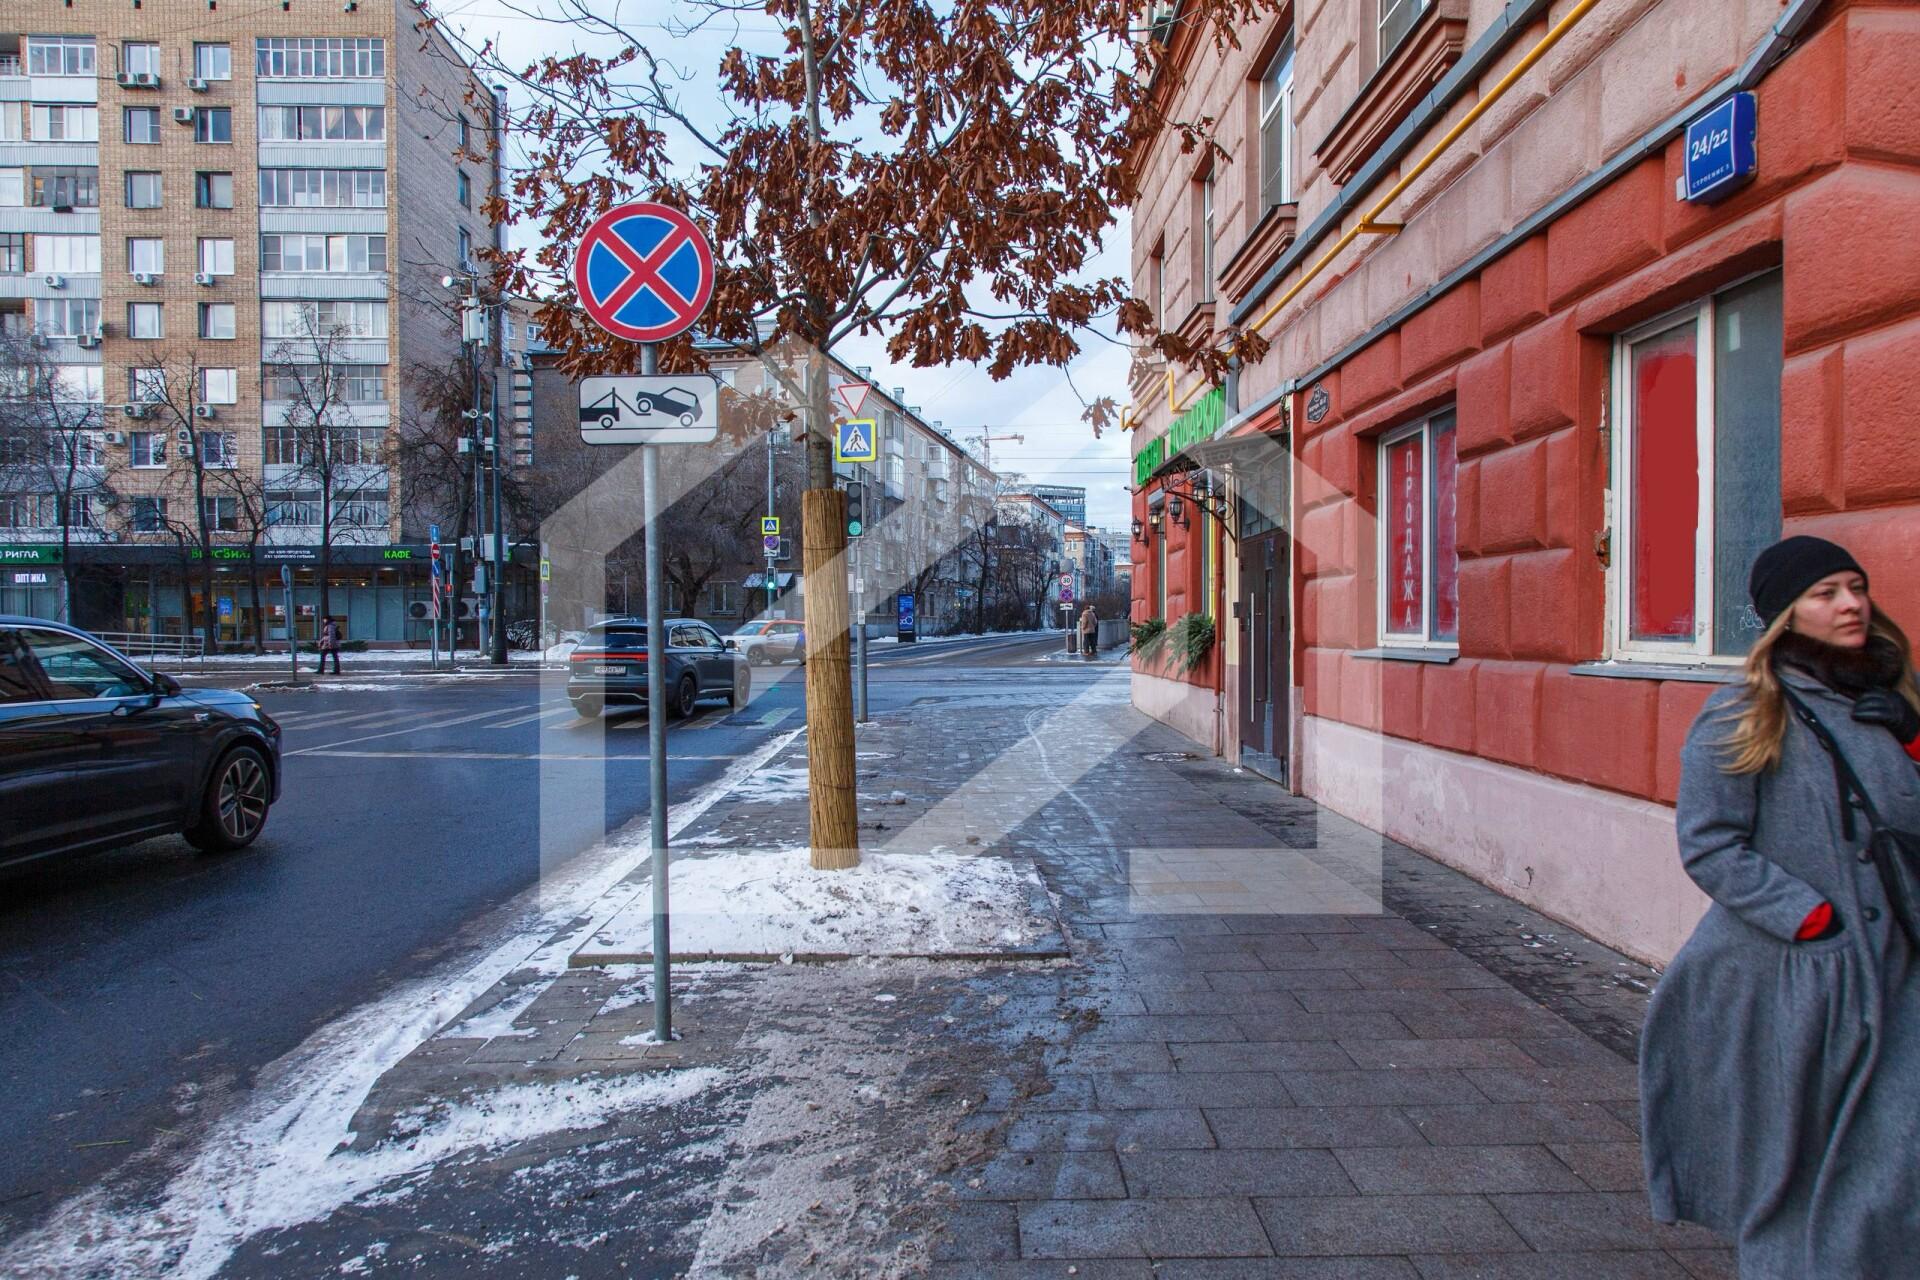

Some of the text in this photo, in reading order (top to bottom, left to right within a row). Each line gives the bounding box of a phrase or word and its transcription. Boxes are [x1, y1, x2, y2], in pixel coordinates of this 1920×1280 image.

[1691, 128, 1729, 162] 24/22
[1168, 387, 1225, 457] ПОДАРКИ
[1404, 450, 1414, 626] ПРОДАЖА
[5, 550, 39, 558] РИГЛА
[384, 550, 411, 559] КАФЕ
[15, 573, 47, 583] ОПТИКА
